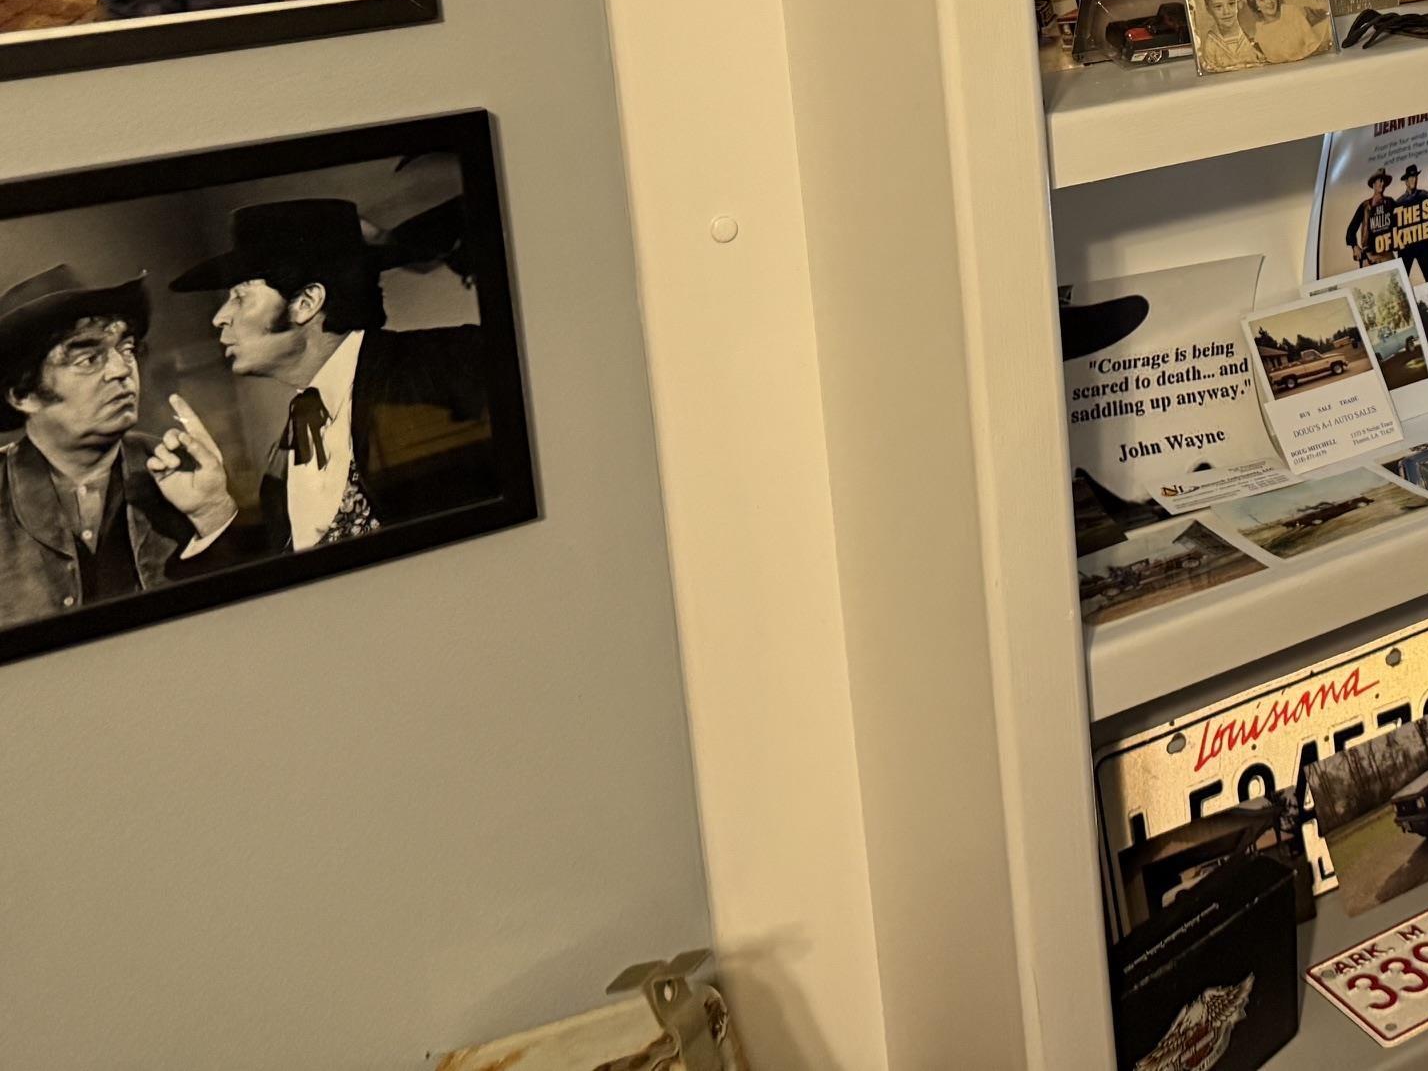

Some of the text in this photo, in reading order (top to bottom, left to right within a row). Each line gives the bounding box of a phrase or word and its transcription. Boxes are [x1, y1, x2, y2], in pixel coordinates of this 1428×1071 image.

[1374, 117, 1406, 137] DEAN
[1370, 212, 1391, 229] WALLIS
[1393, 204, 1420, 227] THE
[1374, 232, 1392, 254] OF
[1089, 341, 1235, 374] "Courage is being
[1072, 357, 1249, 401] scared to death... and
[1071, 378, 1251, 424] saddling up anyway."
[1299, 410, 1311, 419] BUY
[1339, 395, 1360, 406] TRADE
[1293, 423, 1321, 439] DOUG'S
[1334, 414, 1354, 426] AUTO
[1355, 405, 1377, 419] SALES
[1119, 429, 1226, 462] John Wayne
[1290, 438, 1337, 458] DOUG MITCHELL
[1194, 667, 1380, 773] Louisiana
[1400, 923, 1425, 944] M
